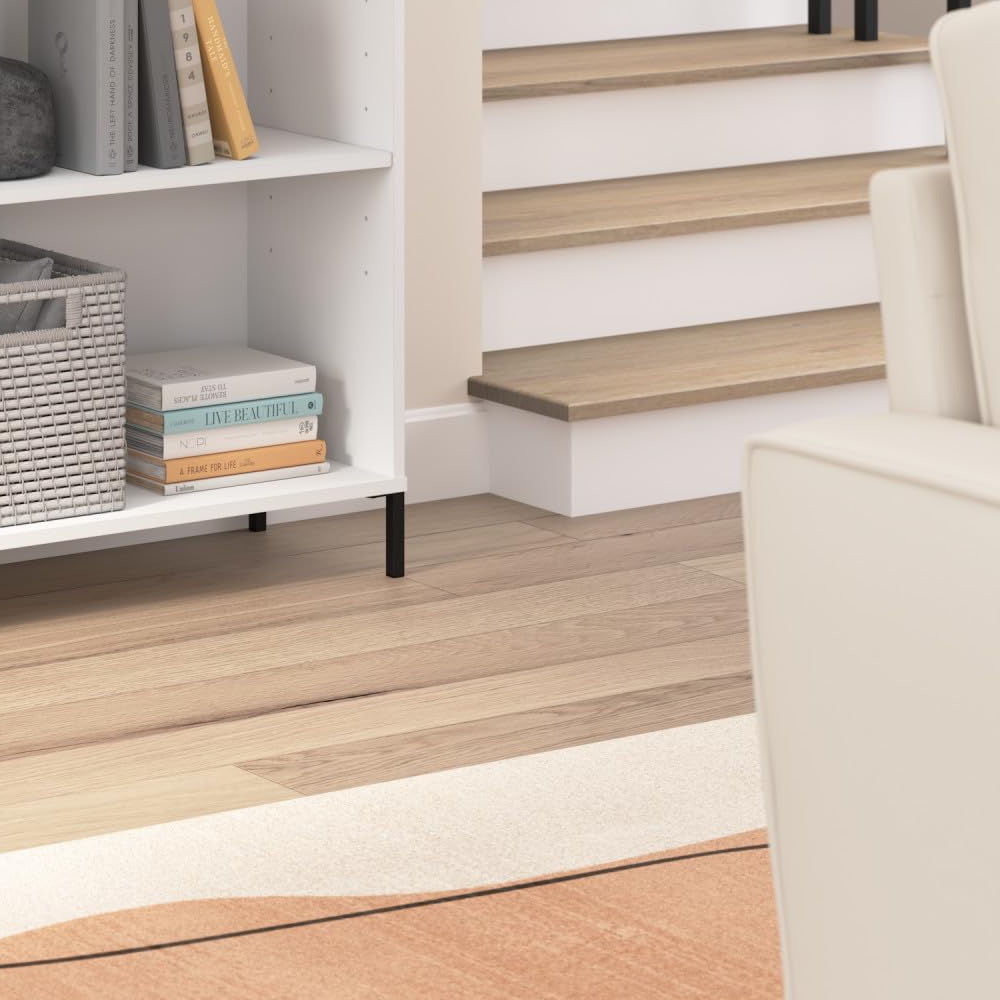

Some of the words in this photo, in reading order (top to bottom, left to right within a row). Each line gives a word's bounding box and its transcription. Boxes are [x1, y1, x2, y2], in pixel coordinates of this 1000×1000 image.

[109, 19, 117, 62] DARKNESS
[109, 81, 117, 106] HAND
[205, 409, 232, 426] LIVE
[234, 401, 298, 425] BEAUTIFUL
[179, 466, 184, 475] A
[187, 463, 208, 475] FRAME
[210, 462, 222, 472] FOR
[224, 460, 237, 470] LIFE
